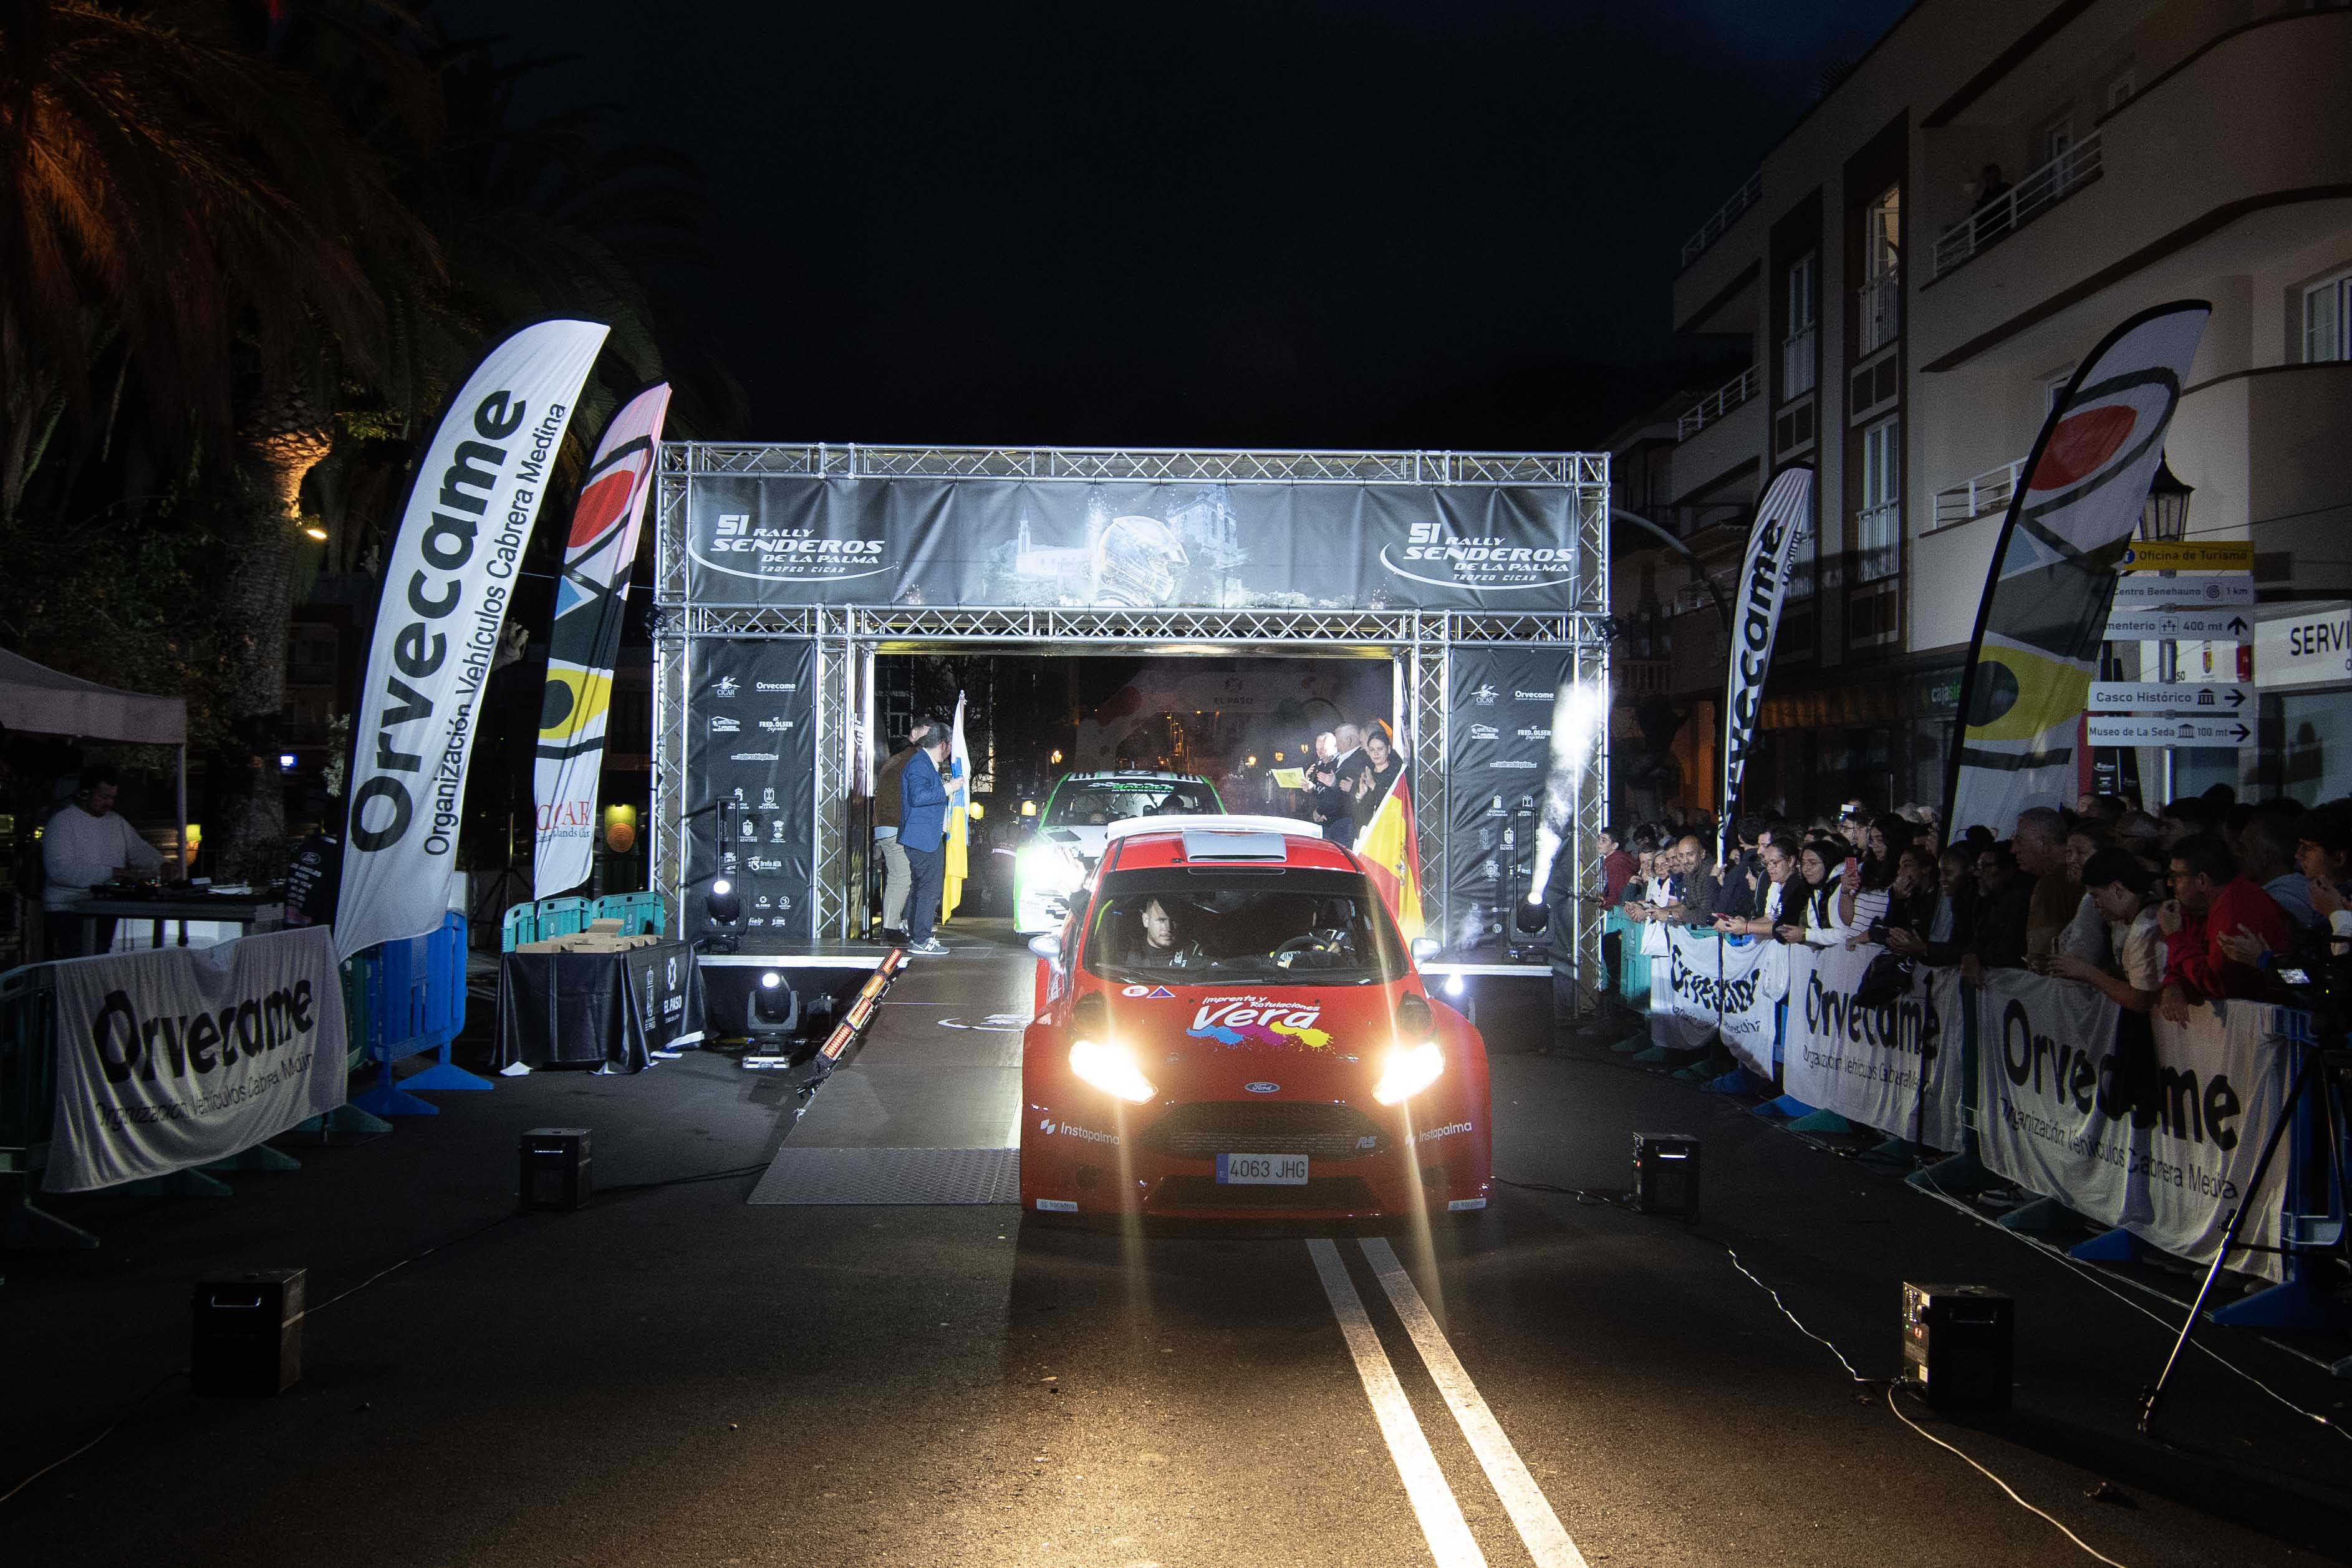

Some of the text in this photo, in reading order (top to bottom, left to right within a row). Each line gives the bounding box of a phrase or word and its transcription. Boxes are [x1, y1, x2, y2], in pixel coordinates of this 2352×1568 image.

[717, 515, 814, 537] 51 RALLY
[1407, 522, 1505, 546] 51 RALLY
[710, 538, 885, 554] SENDEROS
[761, 554, 879, 564] DE LA PALMA
[1402, 547, 1576, 562] SENDEROS
[2139, 550, 2248, 560] Oficina de Turismo
[1453, 562, 1570, 572] DE LA PALMA
[350, 390, 526, 852] Orvecame
[2183, 622, 2203, 631] 400
[2208, 623, 2223, 631] mt
[424, 403, 567, 856] Organización Vehículos Cabrera Medina
[1515, 690, 1554, 698] Orvecame
[2096, 690, 2192, 702] Casco Histórico
[2089, 727, 2229, 736] Museo de La Seda 100 mt
[1202, 995, 1256, 1004] Imprenta
[1250, 1001, 1321, 1011] Rotulaciones
[1193, 1002, 1320, 1030] Vera
[94, 979, 314, 1084] Orvecame
[1252, 1083, 1272, 1091] Ford
[1061, 1122, 1120, 1145] Instapalma
[1419, 1122, 1472, 1142] Instapalma
[1230, 1160, 1305, 1178] 4063 JHG
